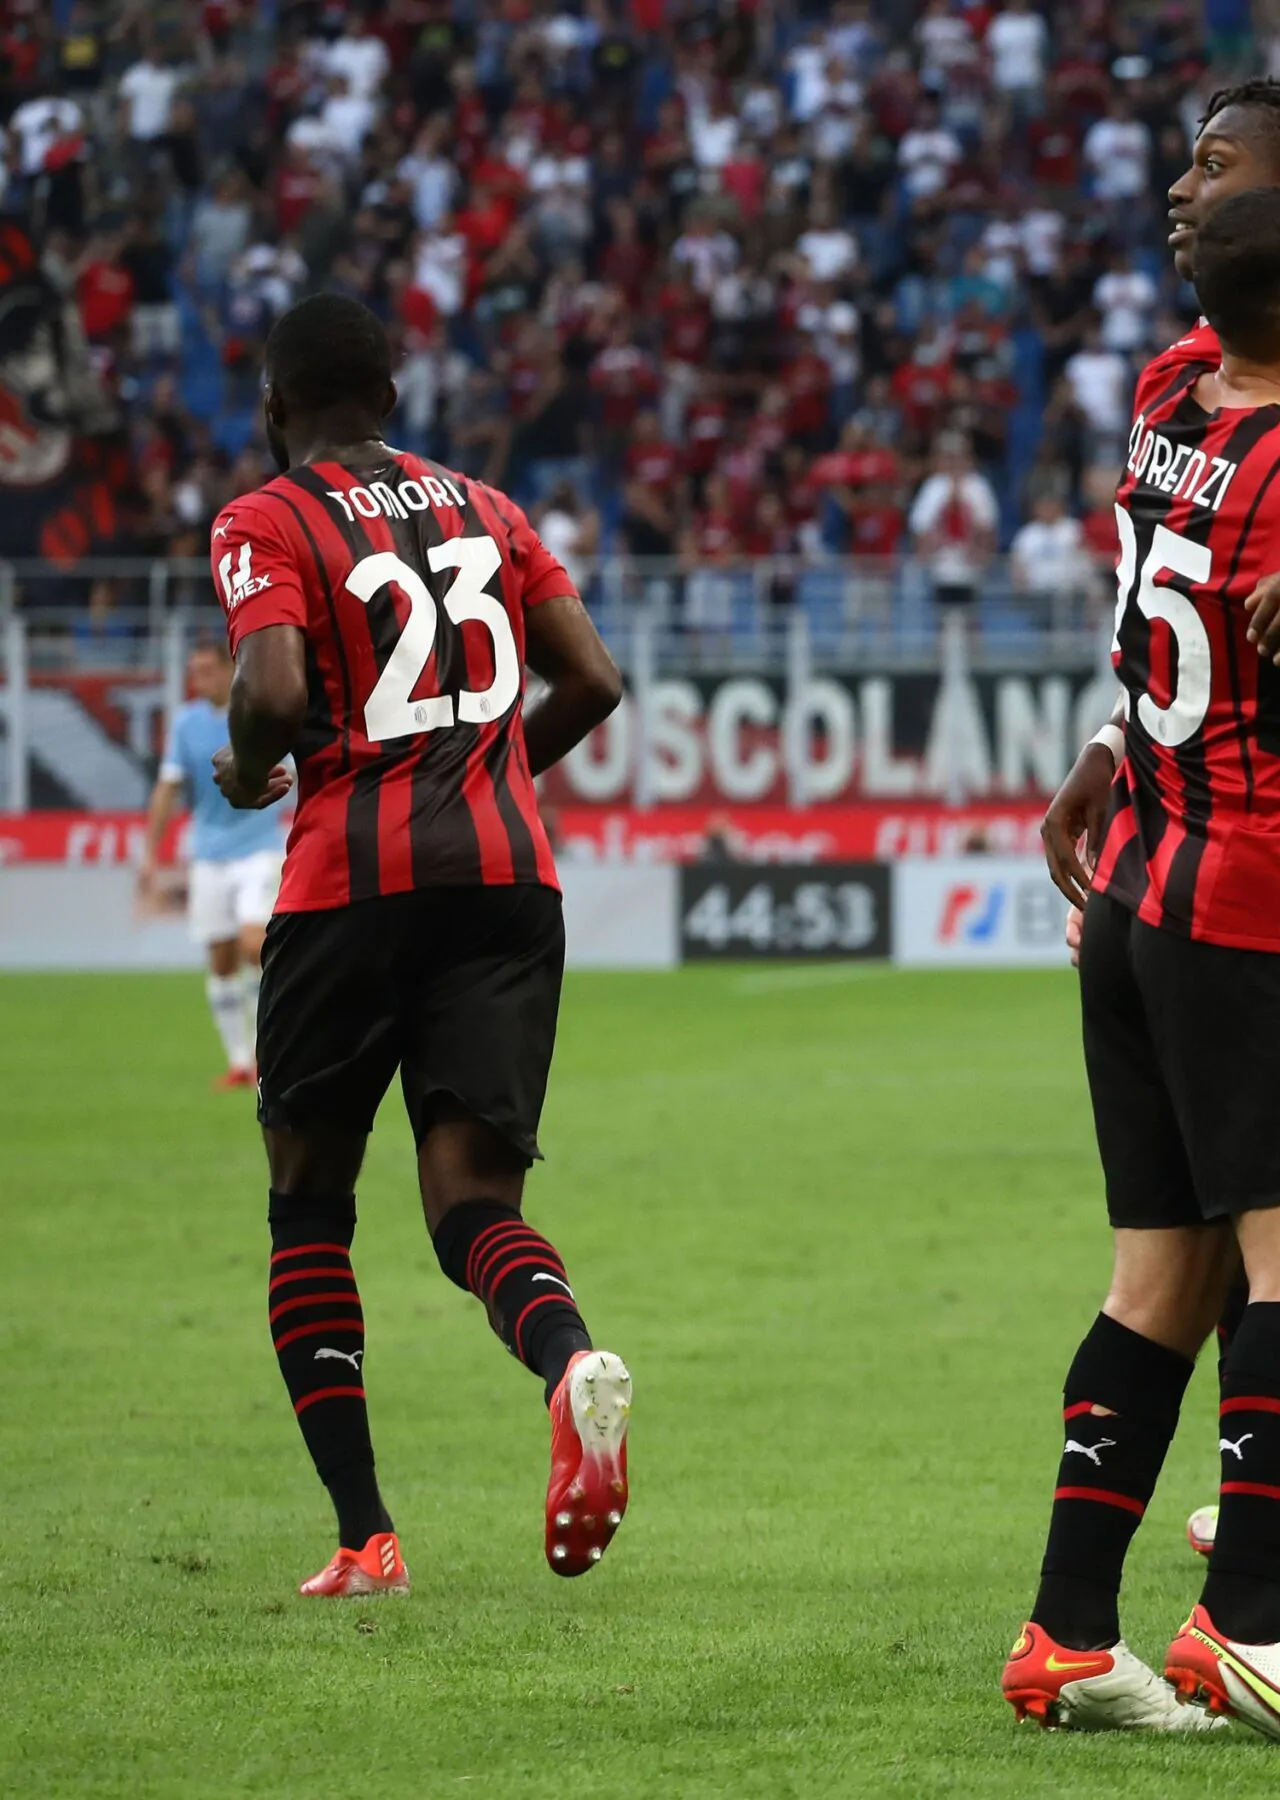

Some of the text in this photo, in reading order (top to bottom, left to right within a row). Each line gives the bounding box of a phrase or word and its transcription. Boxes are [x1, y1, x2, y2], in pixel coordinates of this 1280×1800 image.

[325, 475, 467, 522] TOMORI
[230, 573, 274, 610] MEX
[345, 535, 521, 743] 23
[530, 674, 1125, 803] OSCOLAN
